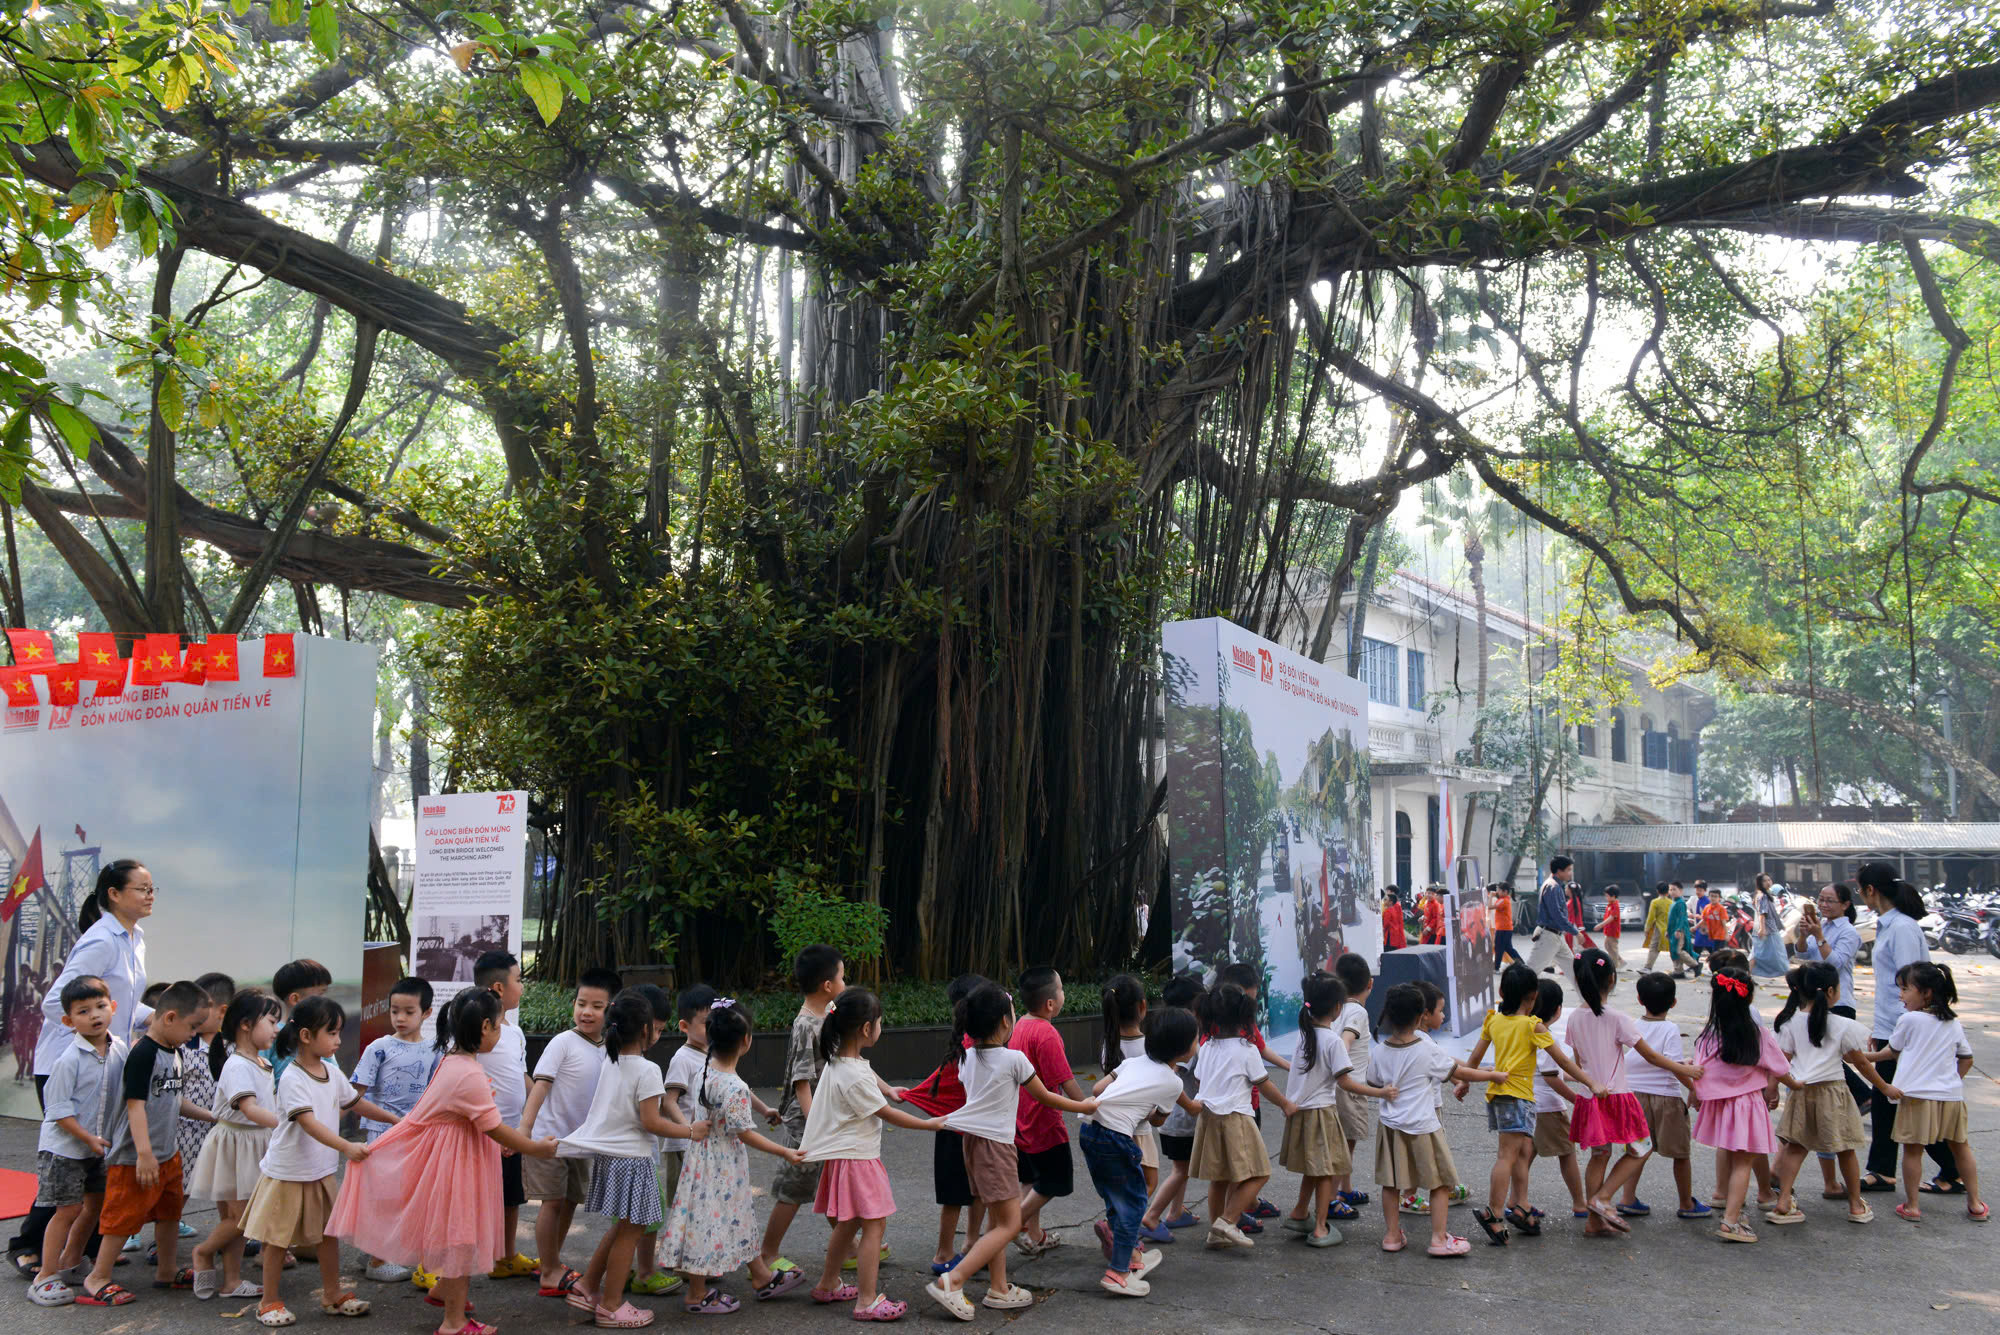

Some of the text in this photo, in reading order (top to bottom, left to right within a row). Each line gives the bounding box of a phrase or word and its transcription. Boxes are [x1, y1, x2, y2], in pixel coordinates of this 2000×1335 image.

[81, 689, 272, 727] ĐÓN MỪNG ĐOÀN QUÂN TIẾN VỀ
[440, 828, 457, 836] LONG
[618, 1320, 644, 1328] crocs
